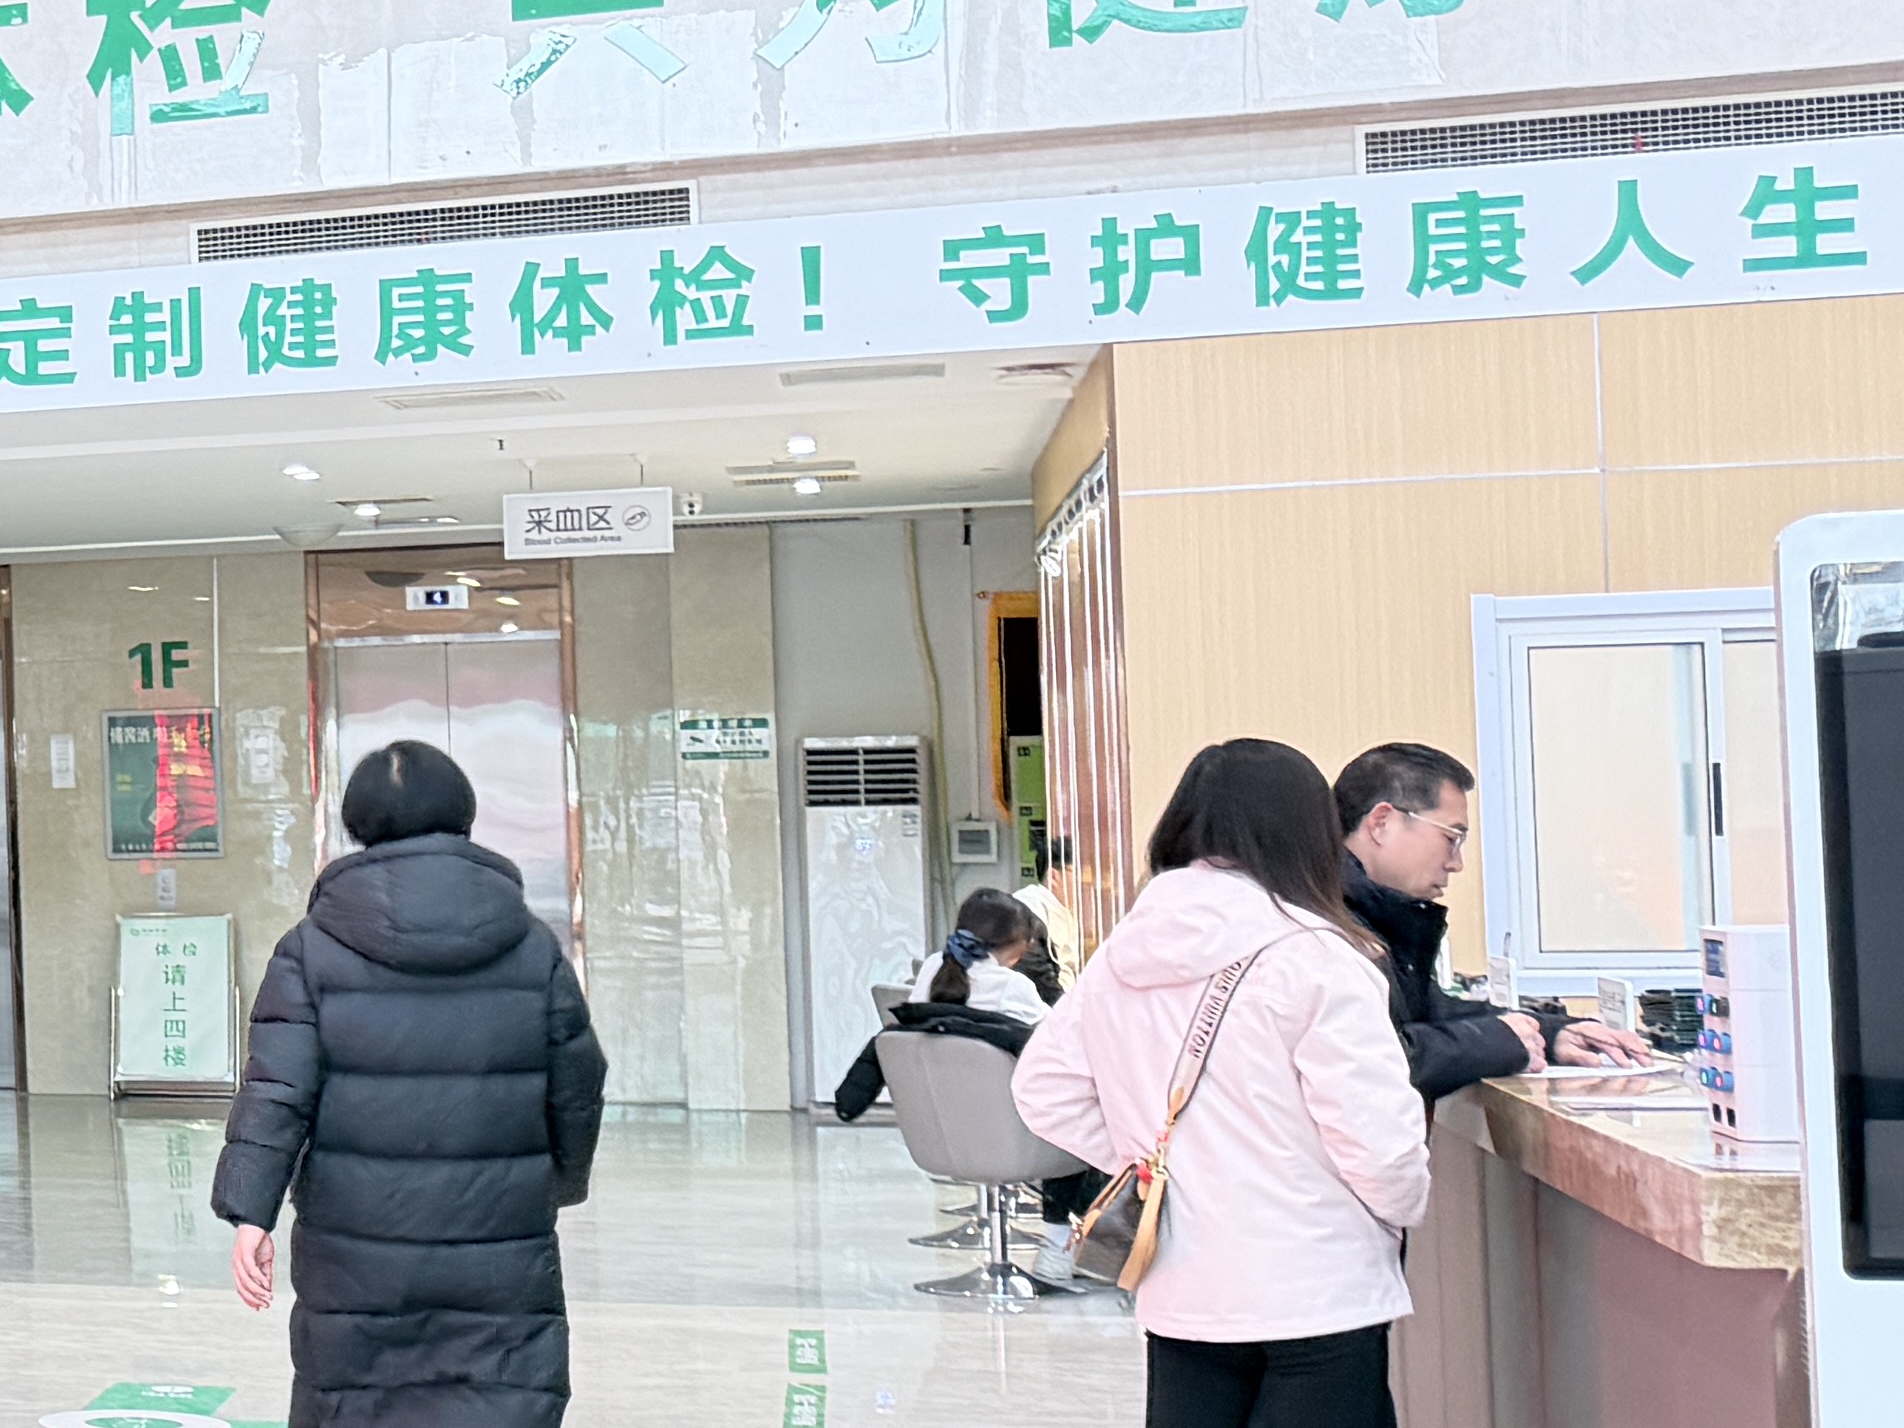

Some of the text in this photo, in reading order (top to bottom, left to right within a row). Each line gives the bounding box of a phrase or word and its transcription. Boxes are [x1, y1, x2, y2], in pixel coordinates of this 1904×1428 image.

[525, 505, 613, 535] 采血区
[128, 641, 189, 689] 1F
[163, 964, 189, 1068] 请上四楼
[1187, 994, 1223, 1059] VUITTON
